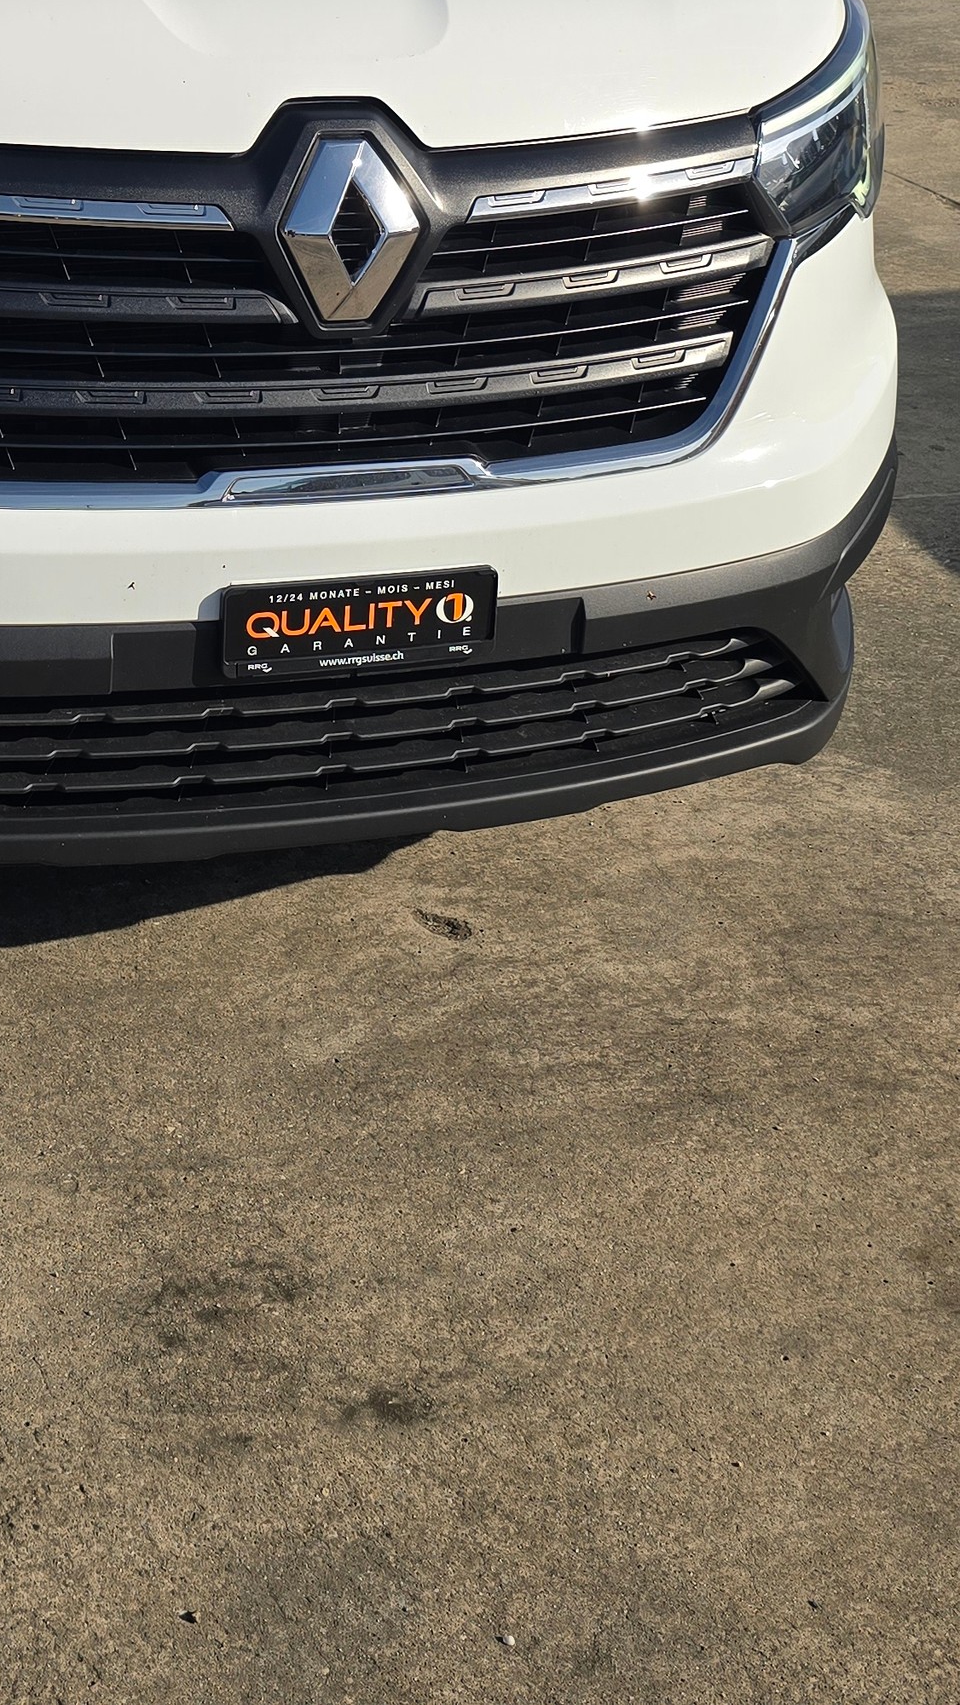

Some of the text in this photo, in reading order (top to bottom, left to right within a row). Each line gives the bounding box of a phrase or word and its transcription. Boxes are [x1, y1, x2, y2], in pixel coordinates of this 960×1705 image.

[269, 593, 303, 604] 12/24
[309, 588, 360, 601] MONATE
[377, 584, 408, 595] MOIS
[425, 579, 455, 590] MESI
[245, 597, 433, 639] QUALITY
[247, 626, 471, 656] GARANTIE
[247, 663, 269, 671] RRG
